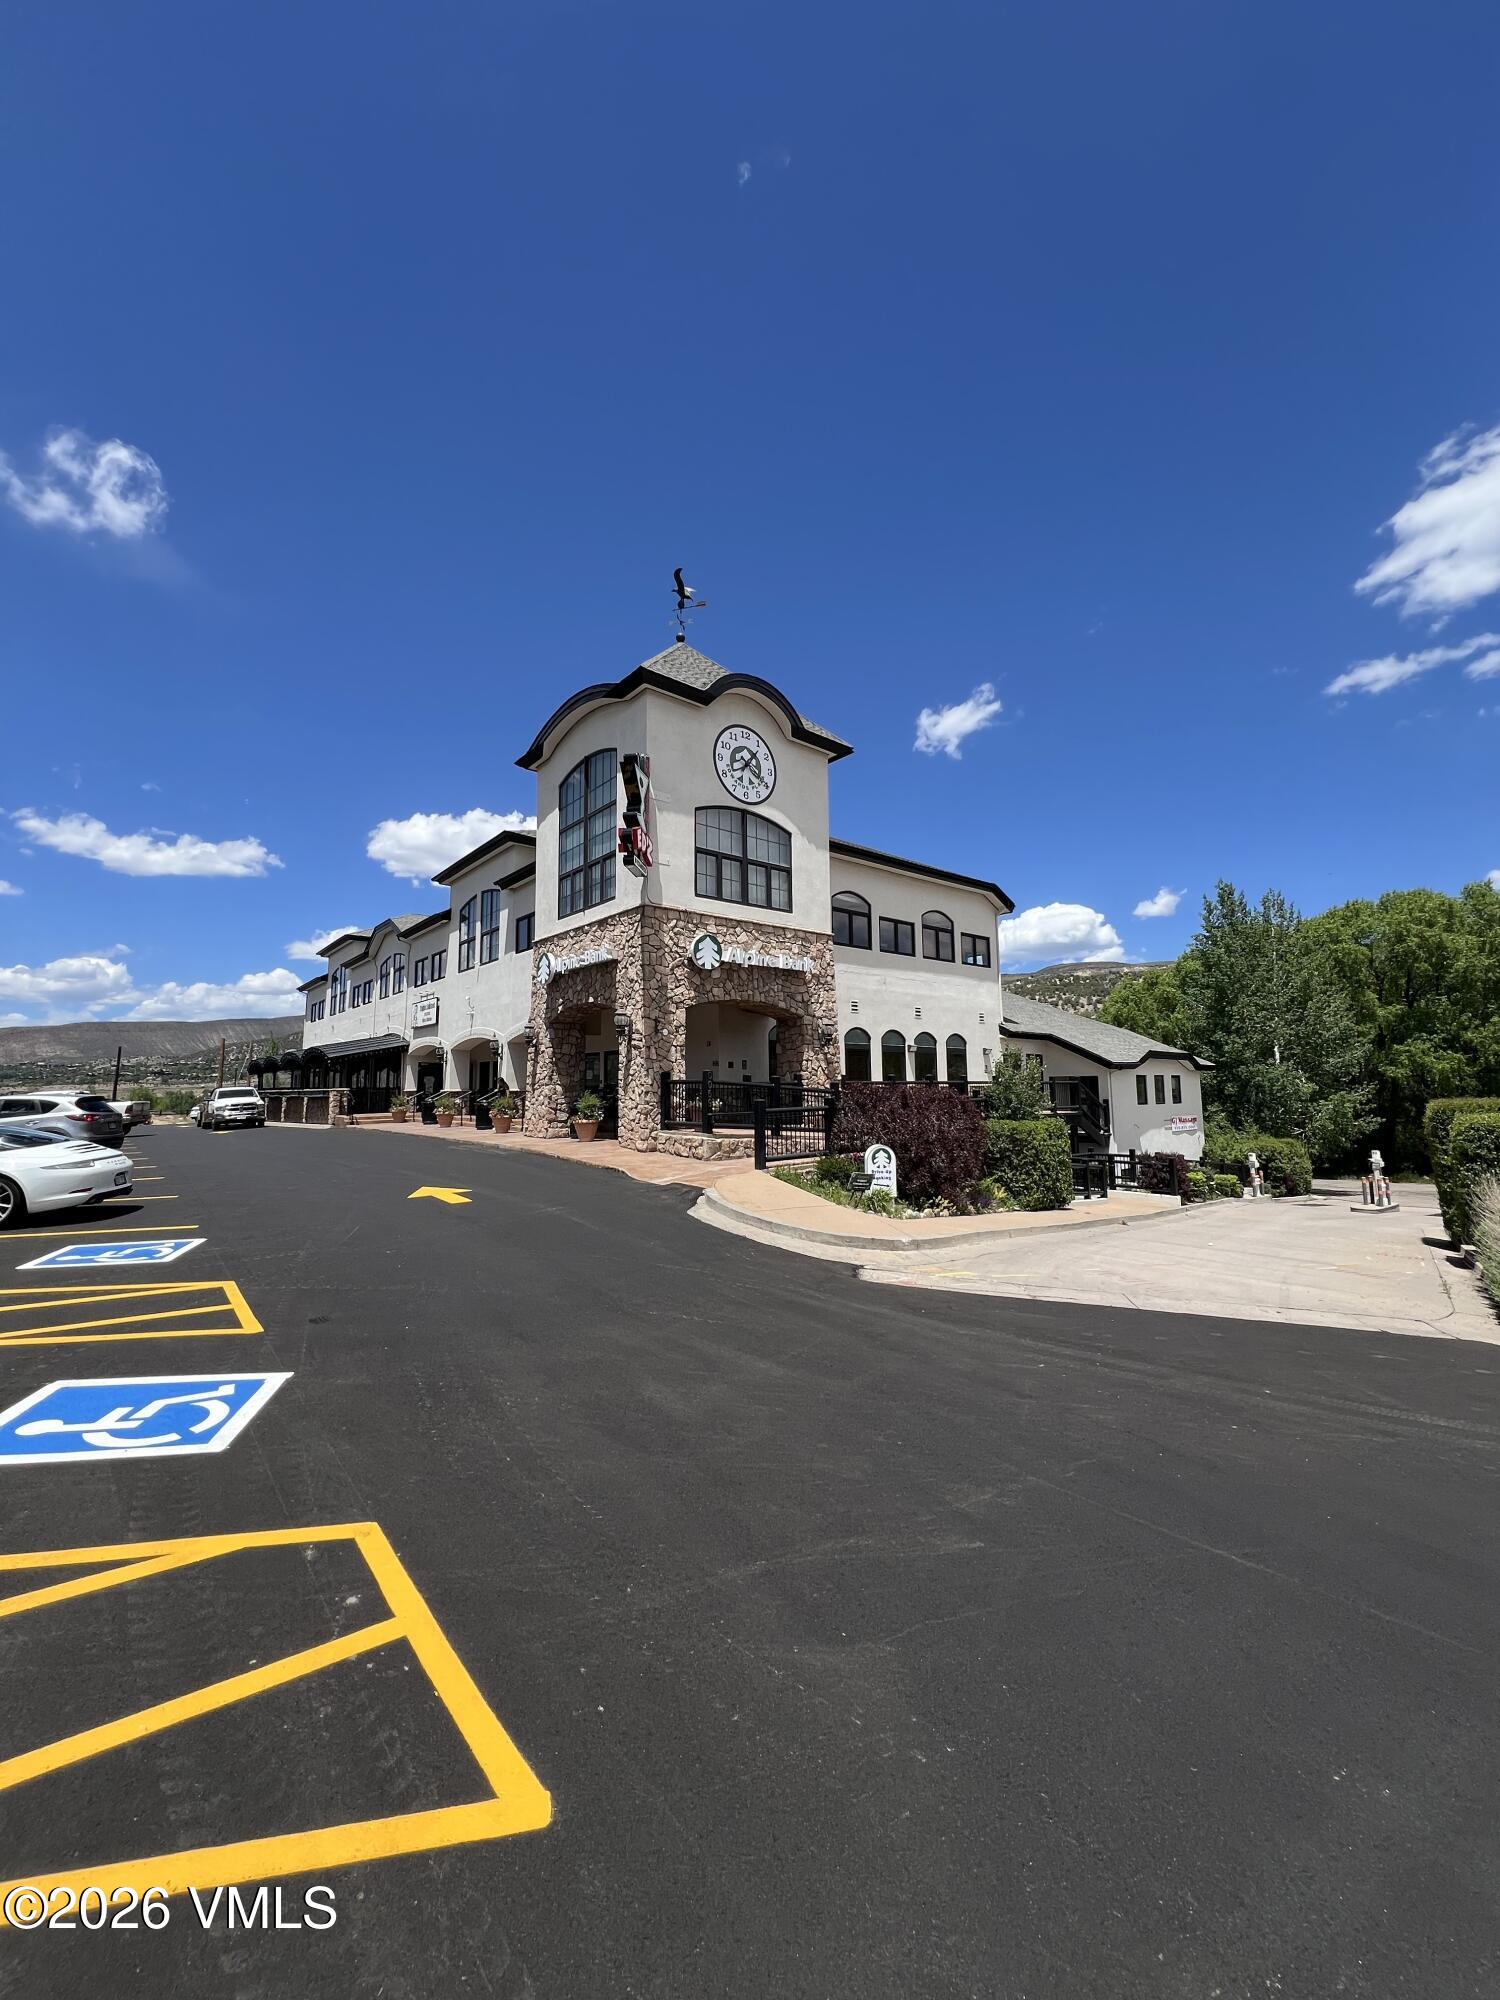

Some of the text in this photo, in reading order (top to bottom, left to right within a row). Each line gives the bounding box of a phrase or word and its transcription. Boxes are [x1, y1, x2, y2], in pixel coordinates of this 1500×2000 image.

[729, 732, 738, 741] 11
[741, 731, 750, 740] 12
[721, 741, 730, 750] 10
[757, 740, 760, 748] 1
[717, 753, 723, 761] 9
[764, 753, 769, 761] 2
[722, 769, 727, 777] 8
[732, 784, 737, 792] 7
[763, 782, 769, 790] 4
[744, 791, 749, 799] 6
[582, 945, 609, 964] Bank
[723, 946, 814, 971] Alpine Bank
